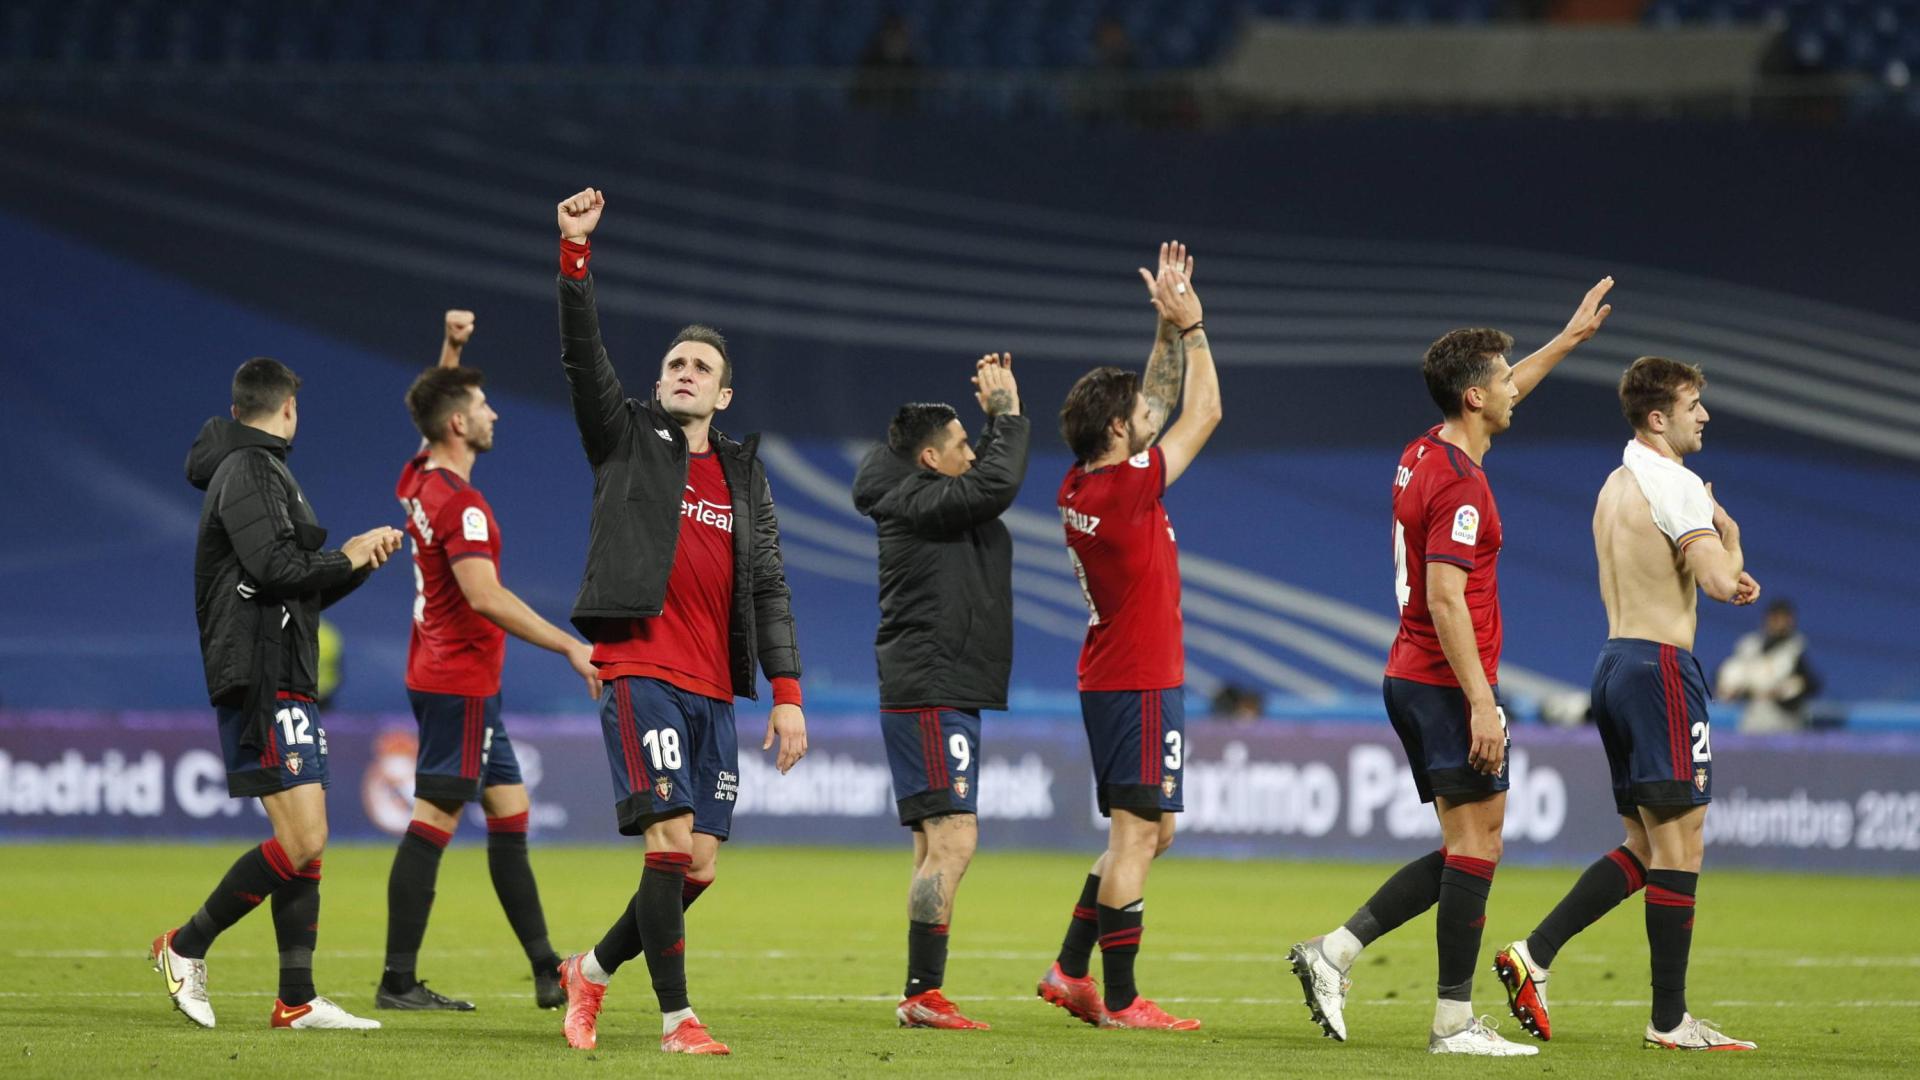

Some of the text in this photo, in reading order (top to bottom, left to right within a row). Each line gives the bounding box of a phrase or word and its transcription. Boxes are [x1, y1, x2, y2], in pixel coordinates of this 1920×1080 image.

[275, 707, 313, 745] 12
[642, 728, 682, 770] 18
[949, 733, 970, 771] 9
[1163, 730, 1182, 770] 3
[0, 748, 165, 816] adrid
[1348, 744, 1567, 842] Pado
